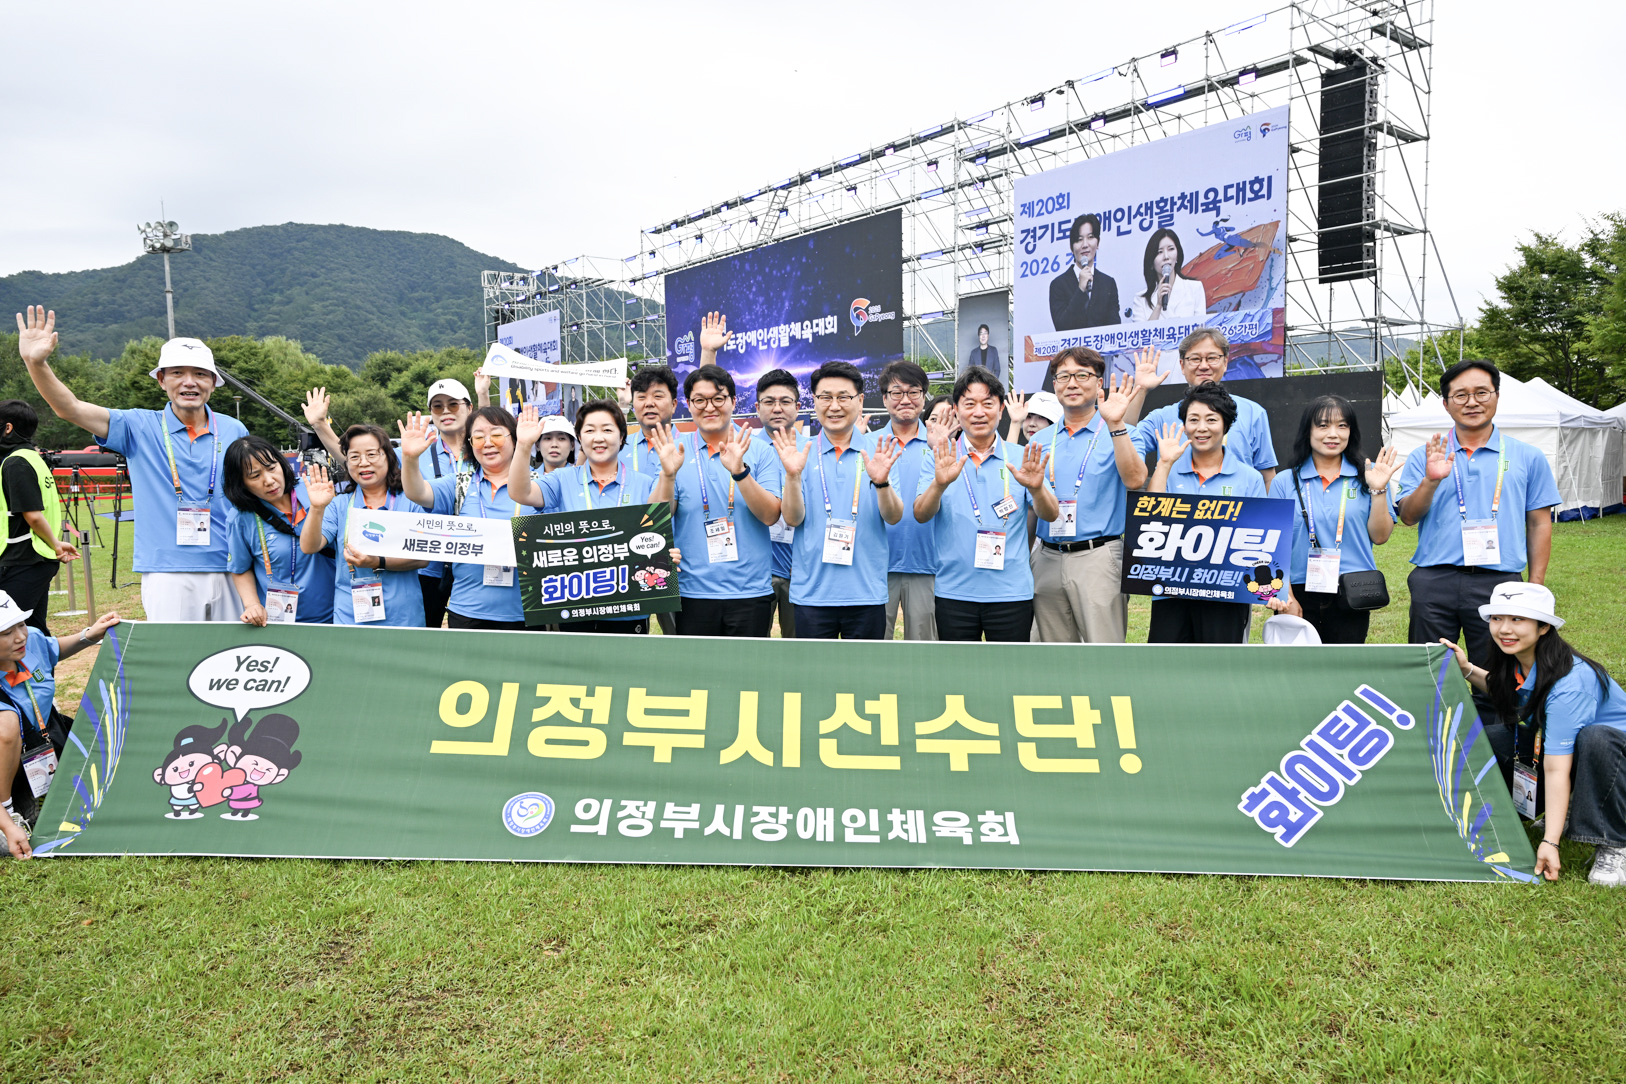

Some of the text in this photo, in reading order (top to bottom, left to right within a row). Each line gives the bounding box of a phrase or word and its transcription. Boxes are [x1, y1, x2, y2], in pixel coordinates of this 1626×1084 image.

[1020, 192, 1070, 218] 제20회
[1020, 175, 1272, 255] 경기도애인생활체육대회
[1020, 255, 1060, 278] 2026
[1035, 345, 1058, 354] 제20회
[1238, 323, 1258, 336] 가평
[1133, 495, 1243, 521] 한계는 없다!
[416, 519, 476, 532] 시민의 뜻으로,
[543, 520, 615, 536] 시민의 뜻으로,
[402, 539, 483, 556] 새로운 의정부
[532, 543, 630, 568] 새로운 의정부
[646, 542, 660, 550] can!
[1132, 521, 1282, 567] 화이팅
[542, 565, 629, 604] 화이팅!
[1127, 564, 1244, 587] 의정부시 화이팅!
[1164, 586, 1235, 599] 의정부시장애인체육회
[571, 603, 640, 617] 의정부시장애인체육회
[235, 656, 280, 673] Yes!
[209, 676, 291, 693] we can!
[429, 680, 1144, 775] 의정부시선수단!
[1237, 683, 1416, 848] 화이팅!
[569, 797, 1021, 846] 의정부시장애인체육회
